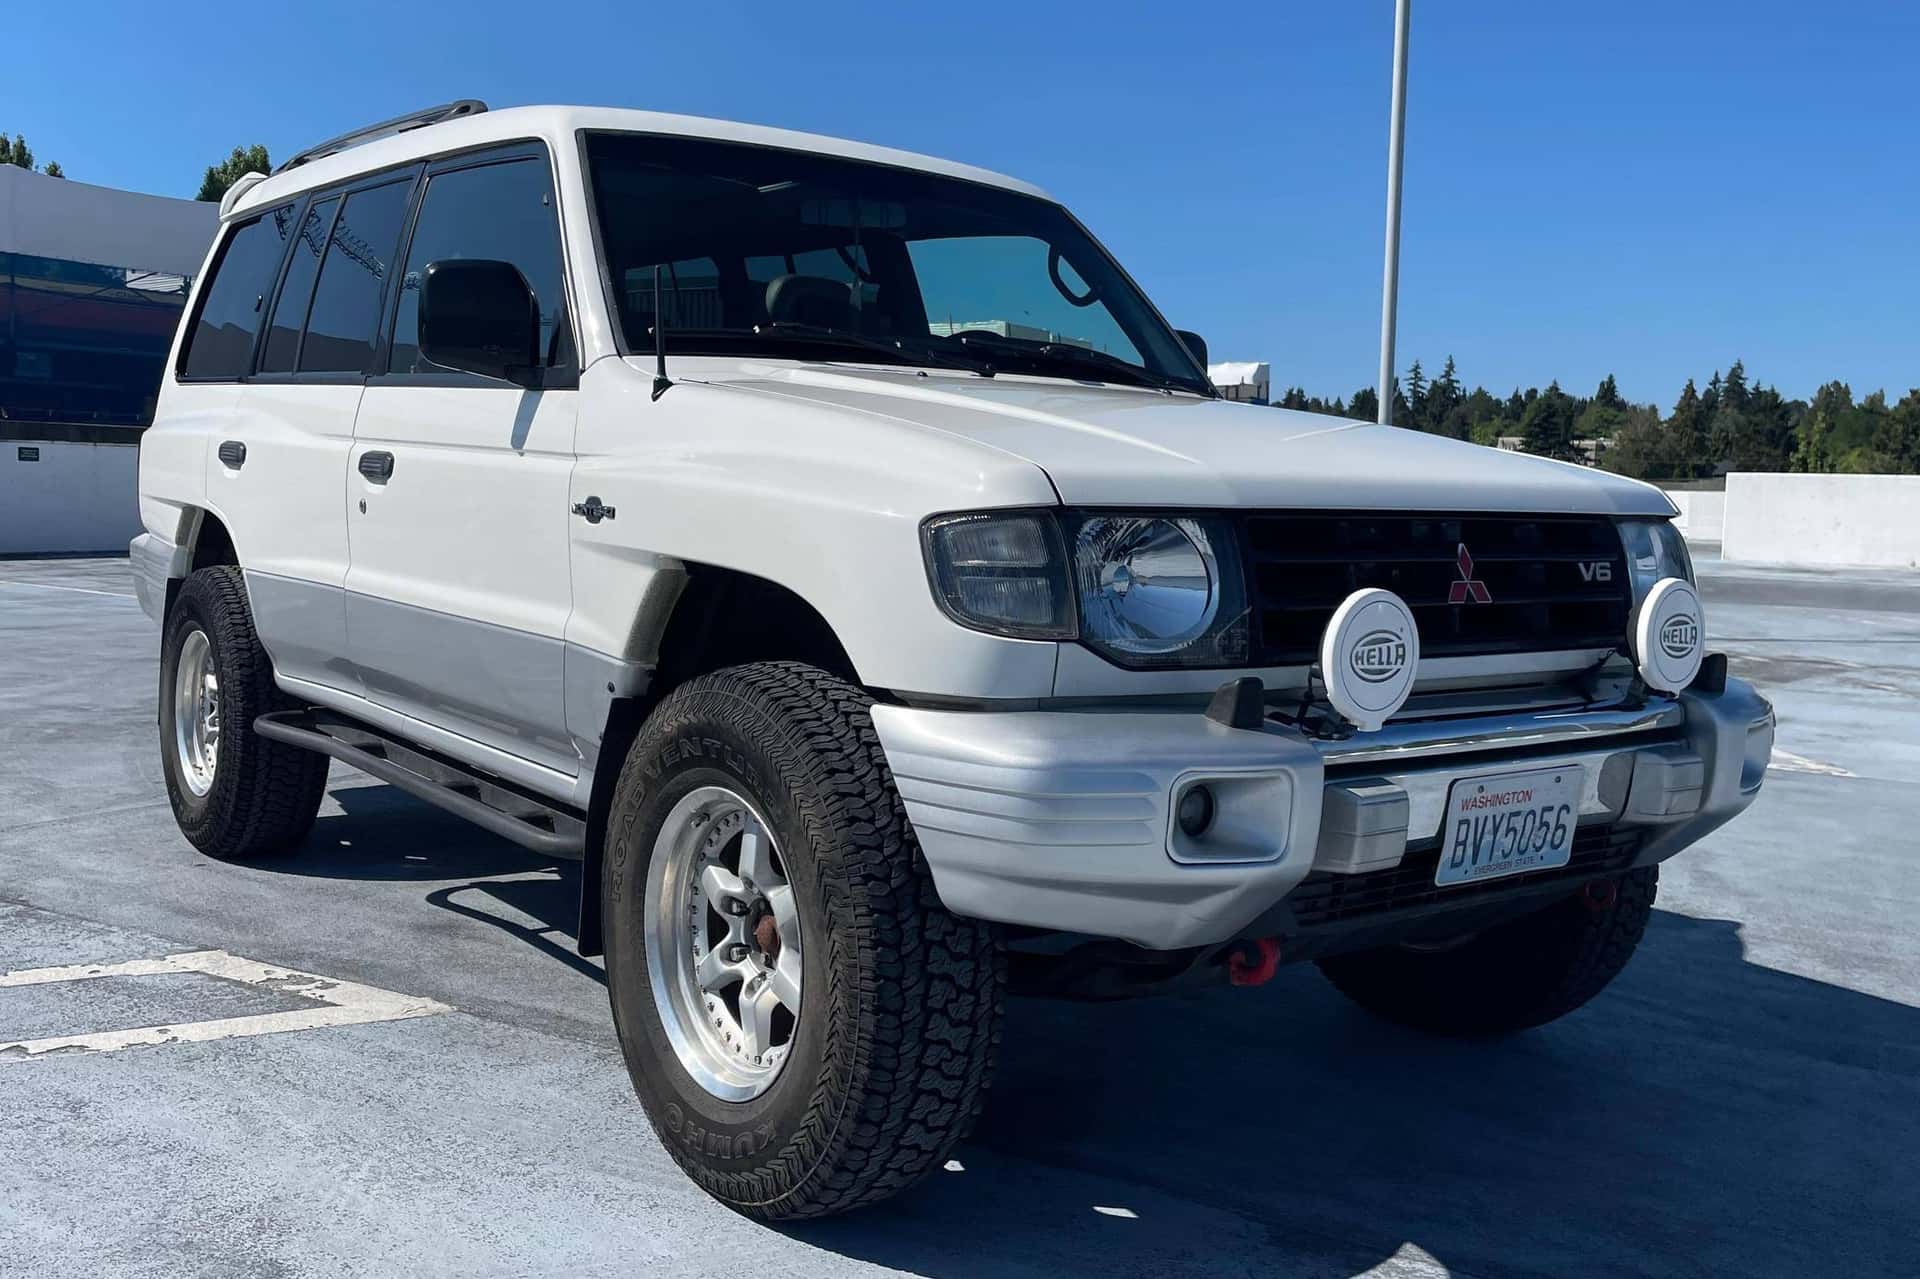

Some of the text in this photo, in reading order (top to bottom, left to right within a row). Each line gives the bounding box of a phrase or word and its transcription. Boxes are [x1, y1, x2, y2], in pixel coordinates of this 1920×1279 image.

[1578, 562, 1612, 582] V6
[1663, 624, 1698, 649] HELLA
[1354, 643, 1406, 668] HELLA
[1461, 789, 1533, 812] WASHINGTON
[609, 782, 646, 904] ROAD
[1450, 804, 1571, 870] BVY5056
[664, 1102, 777, 1160] KUMHO
